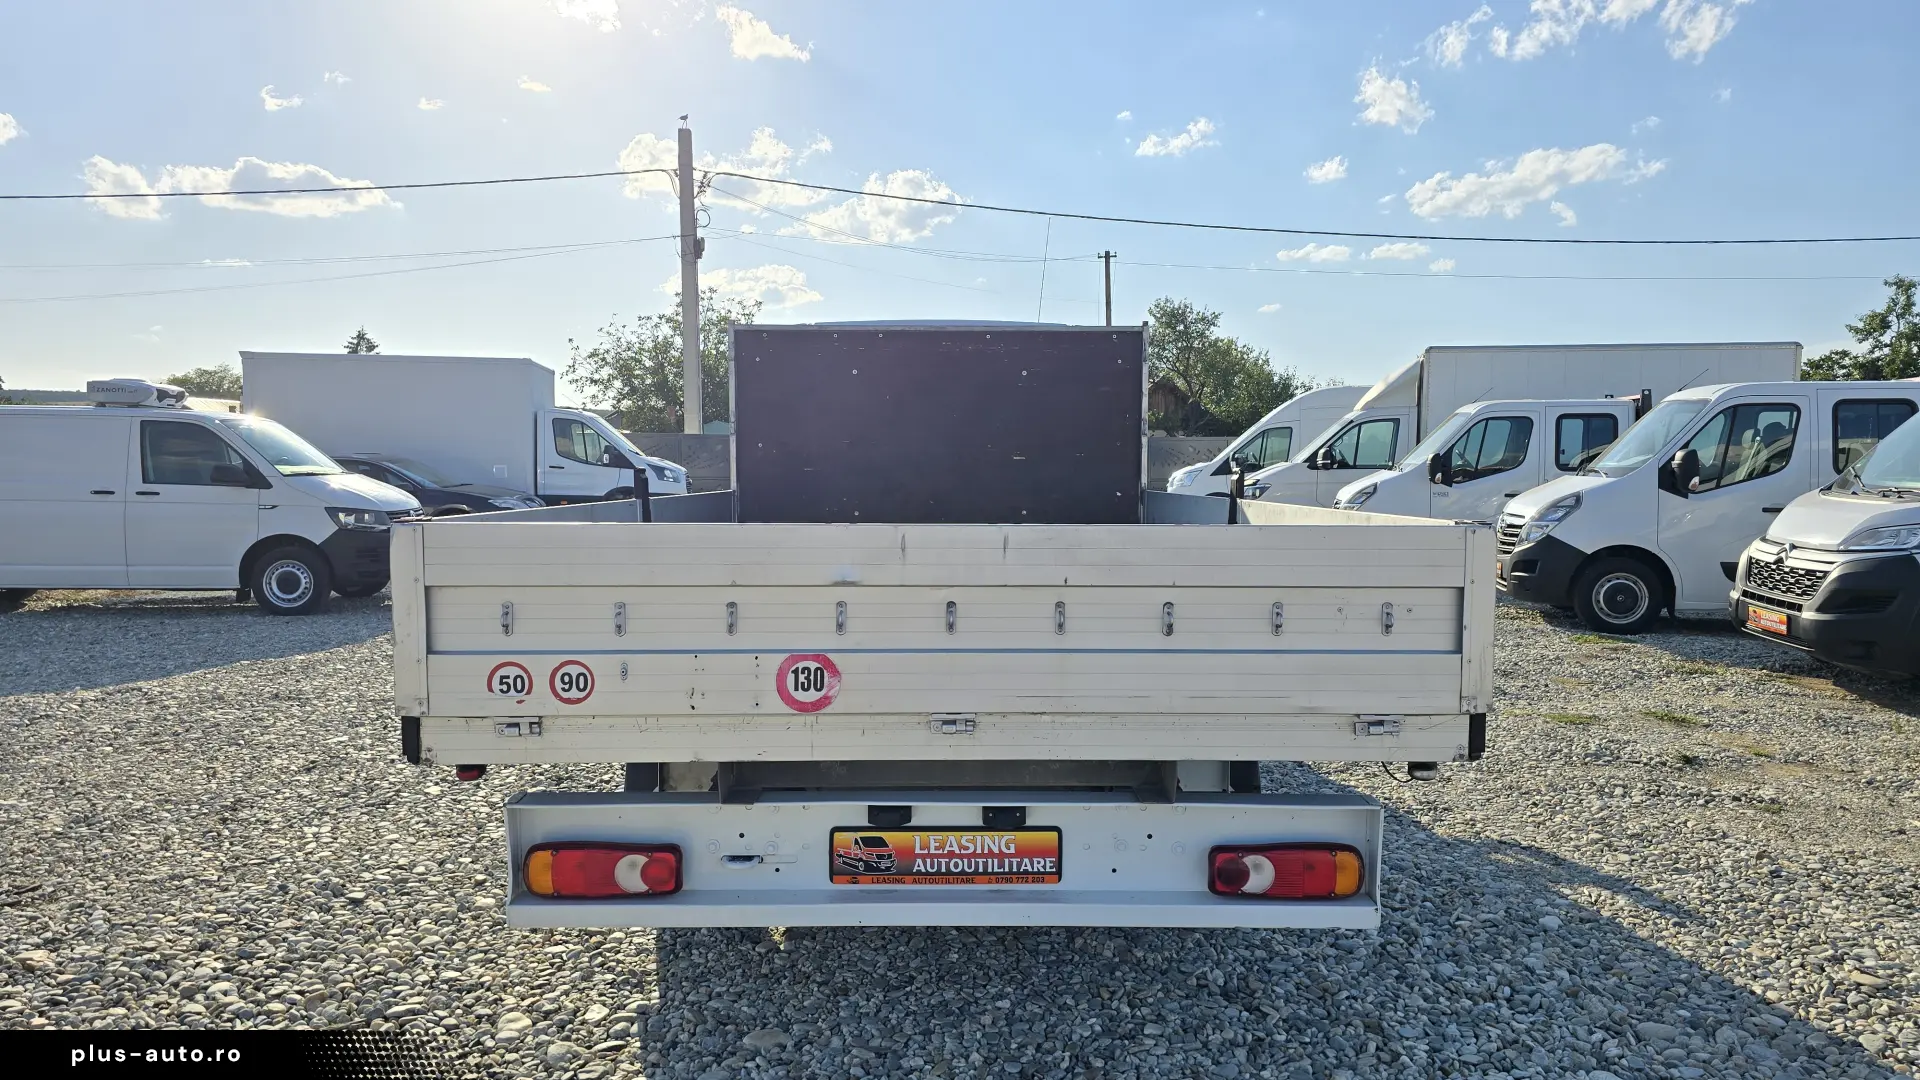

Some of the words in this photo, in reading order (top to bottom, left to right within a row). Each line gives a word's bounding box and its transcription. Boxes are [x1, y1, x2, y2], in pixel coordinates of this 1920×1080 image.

[498, 674, 526, 695] 50
[560, 672, 589, 693] 90
[790, 666, 825, 692] 130
[912, 834, 1016, 854] LEASING
[912, 858, 1057, 873] AUTOUTILITARE
[995, 876, 1013, 884] 0790
